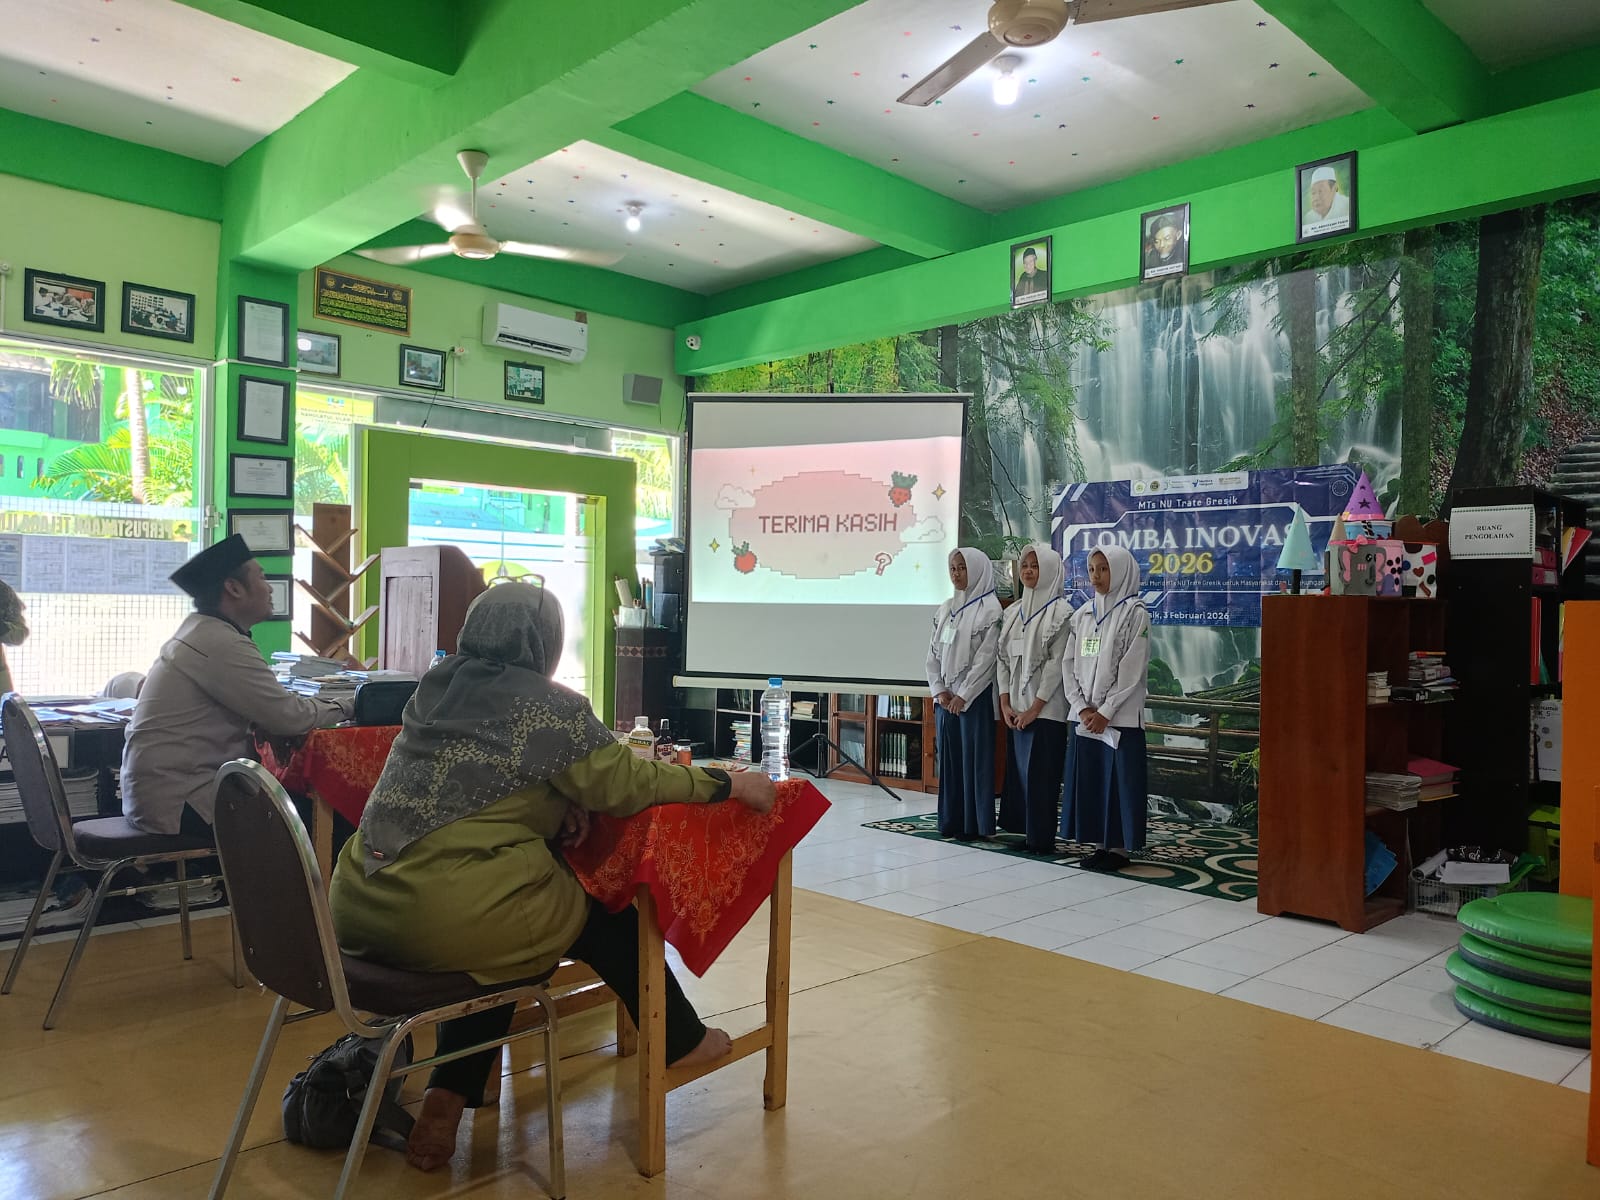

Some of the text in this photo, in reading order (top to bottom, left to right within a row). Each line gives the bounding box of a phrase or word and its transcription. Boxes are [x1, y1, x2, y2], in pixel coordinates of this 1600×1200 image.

[1138, 495, 1238, 510] MTs NU Trate Gresik
[758, 512, 898, 534] TERIMA KASIH
[1082, 527, 1178, 551] LOMBA
[1464, 532, 1515, 540] PENGOLAHAN
[1149, 552, 1213, 574] 2026
[1163, 611, 1169, 619] 3
[1170, 611, 1206, 619] Februari
[1207, 612, 1230, 620] 2026
